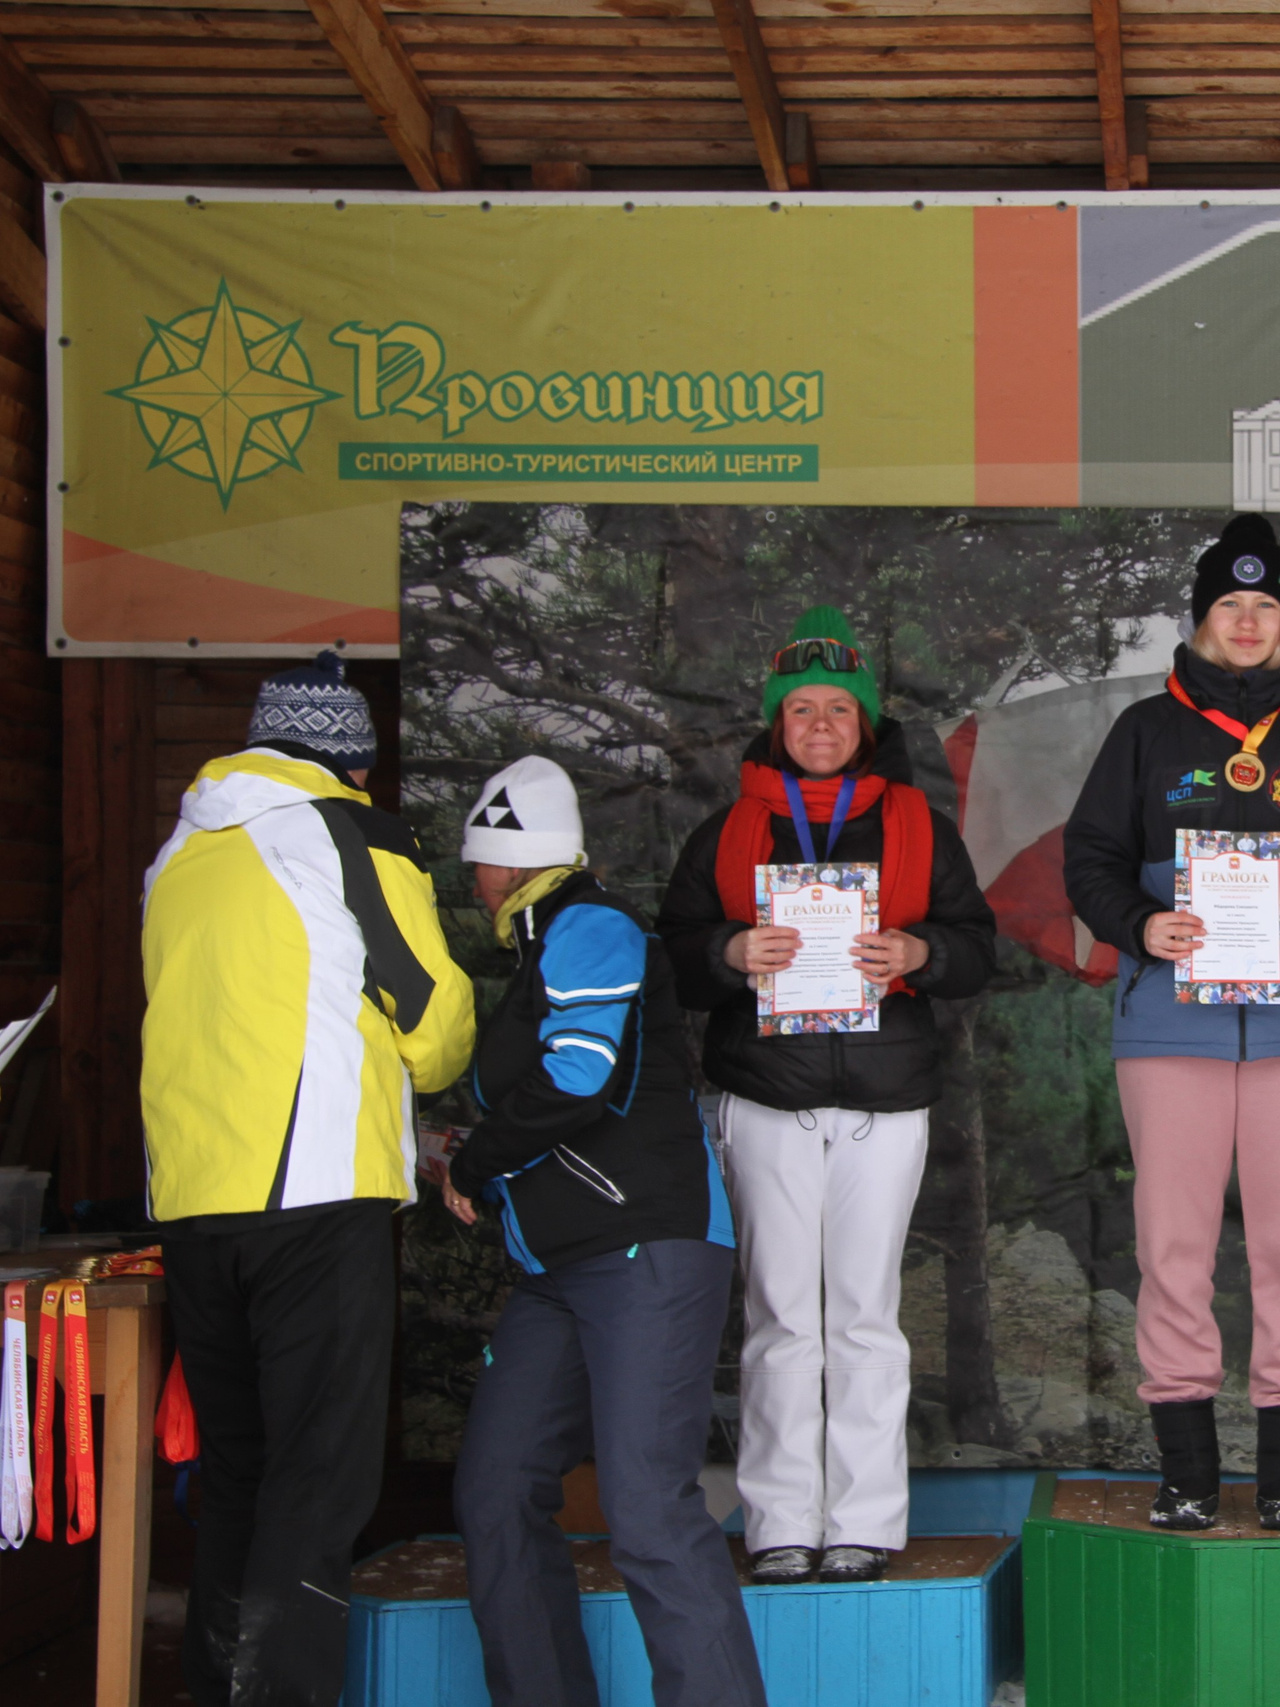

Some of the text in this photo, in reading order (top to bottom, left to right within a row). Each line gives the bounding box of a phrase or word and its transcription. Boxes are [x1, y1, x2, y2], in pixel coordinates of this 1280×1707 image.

[329, 320, 824, 439] Провинция
[354, 451, 803, 476] СПОРТИВНО-ТУРИСТИЧЕСКИЙ ЦЕНТР
[1166, 786, 1193, 803] ЦСП
[1201, 871, 1269, 884] ГРАМОТА
[783, 903, 852, 917] ГРАМОТА
[75, 1333, 89, 1454] ЧЕЛЯБИНСКАЯ ОБЛАСТЬ
[15, 1411, 25, 1457] ОБЛАСТЬ
